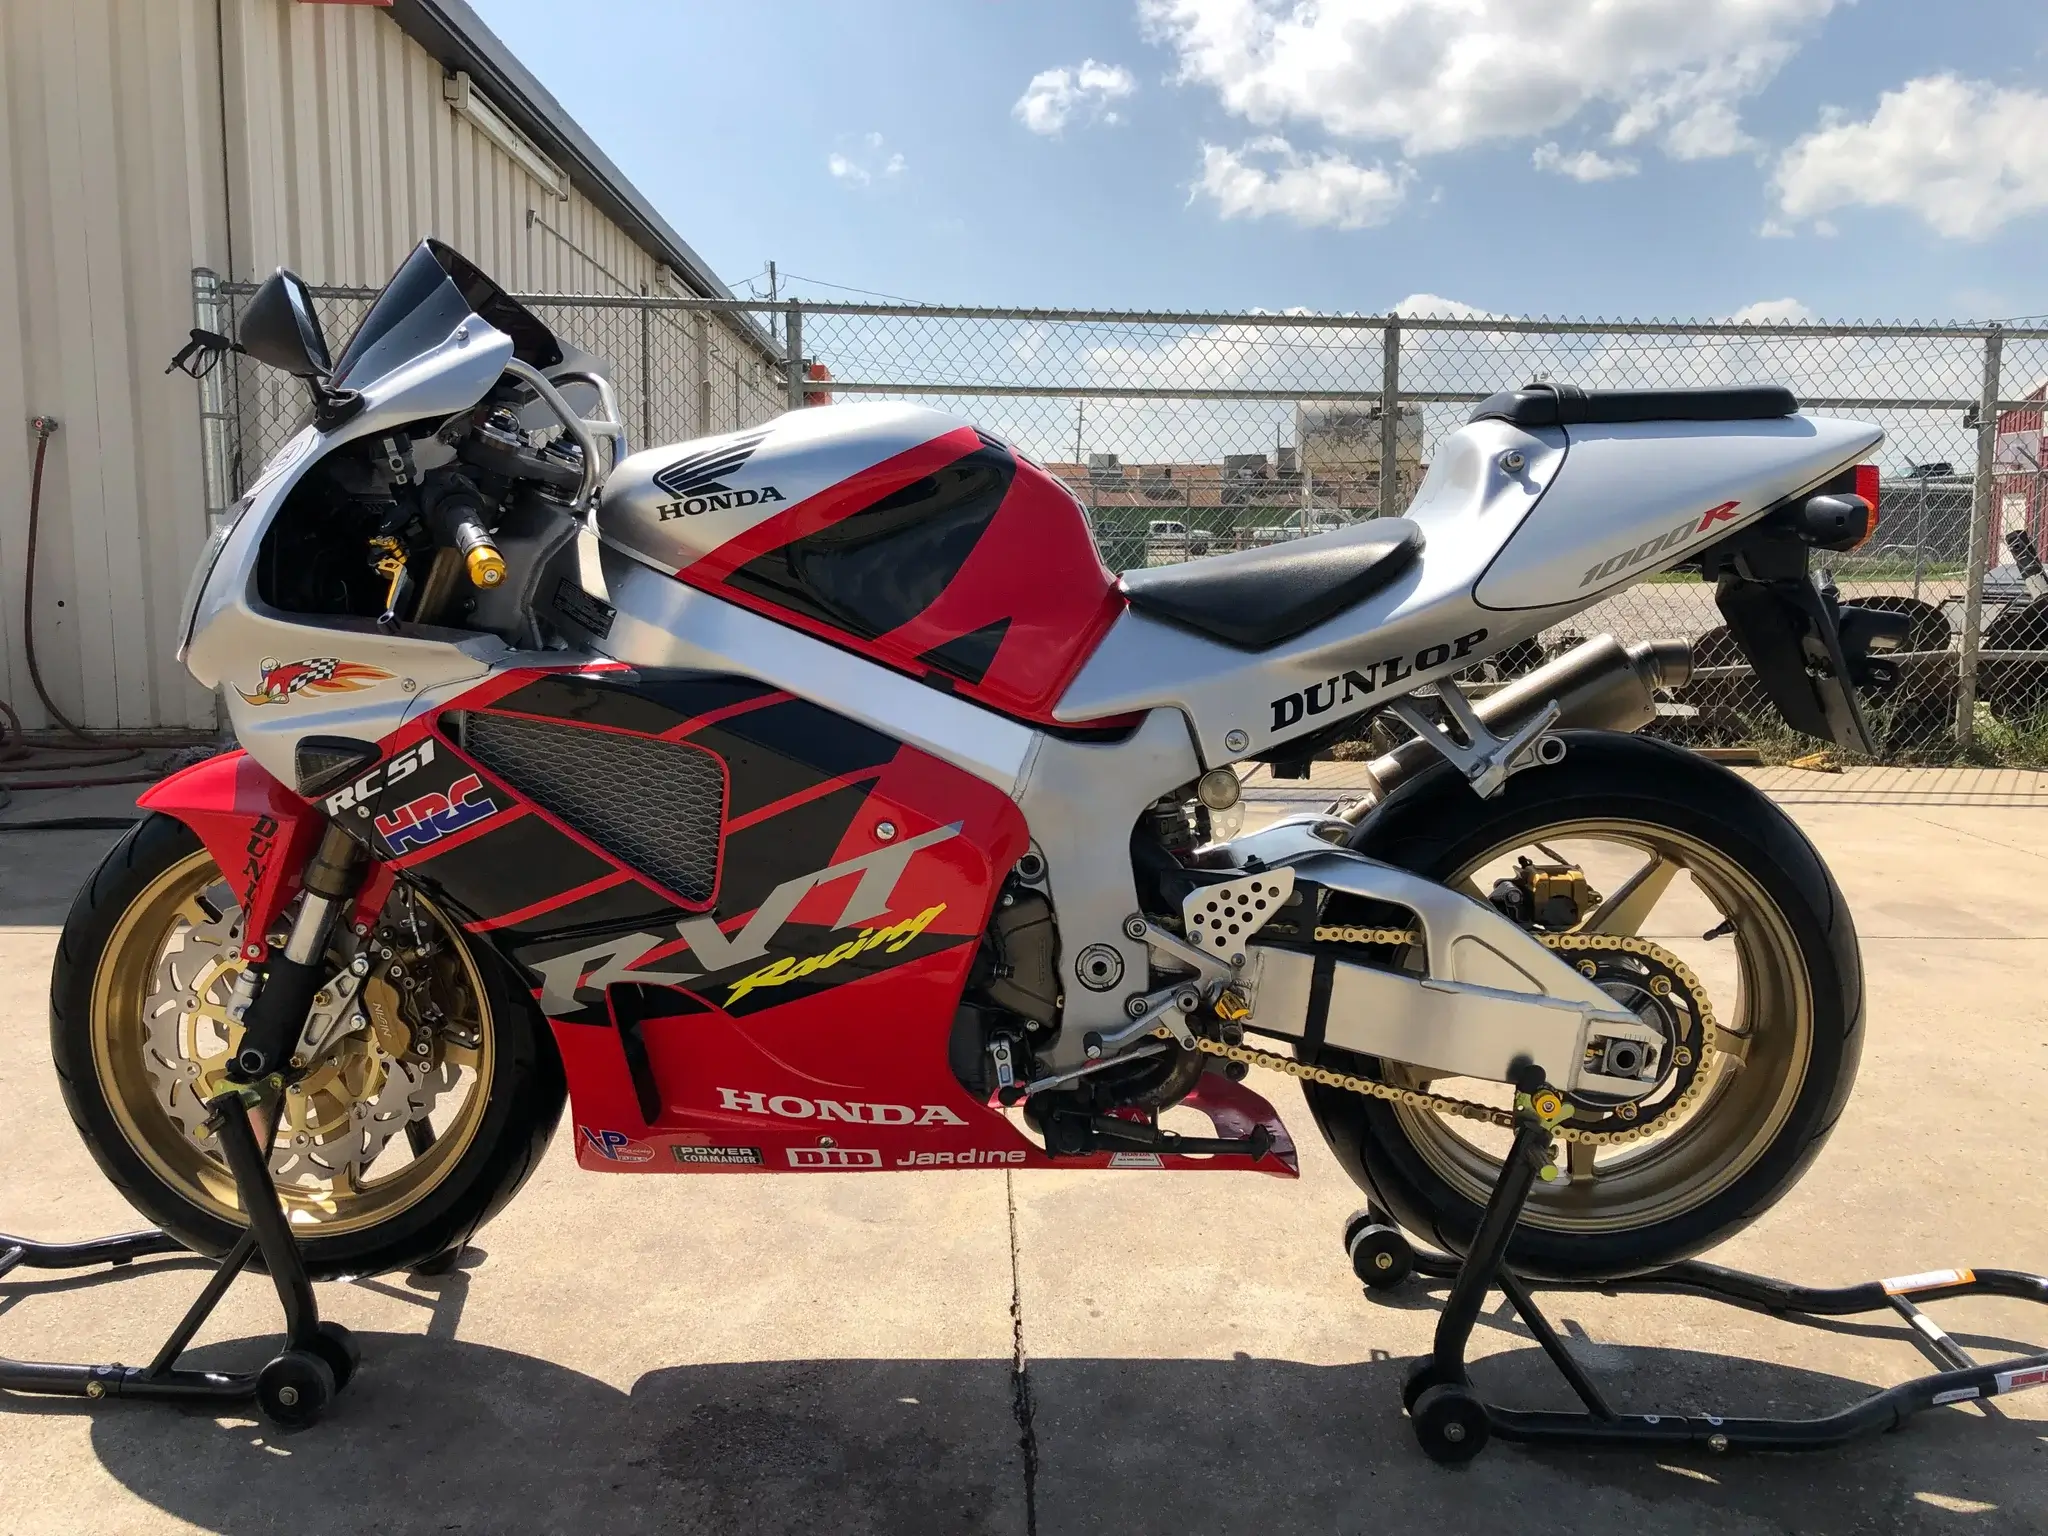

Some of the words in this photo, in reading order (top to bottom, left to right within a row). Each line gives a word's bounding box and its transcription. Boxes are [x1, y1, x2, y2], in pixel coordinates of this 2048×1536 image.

[656, 486, 786, 521] HONDA
[1579, 501, 1742, 588] 1000R
[1270, 628, 1489, 732] DUNLOP
[325, 738, 435, 817] RC51
[374, 773, 498, 855] HRC
[243, 814, 278, 921] DUNLO
[527, 820, 965, 1016] RVT
[722, 902, 948, 1009] Racing
[579, 1125, 629, 1160] VP
[716, 1087, 970, 1126] HONDA
[681, 1146, 753, 1156] POWER
[683, 1155, 757, 1164] COMMANDER
[794, 1150, 876, 1165] DID
